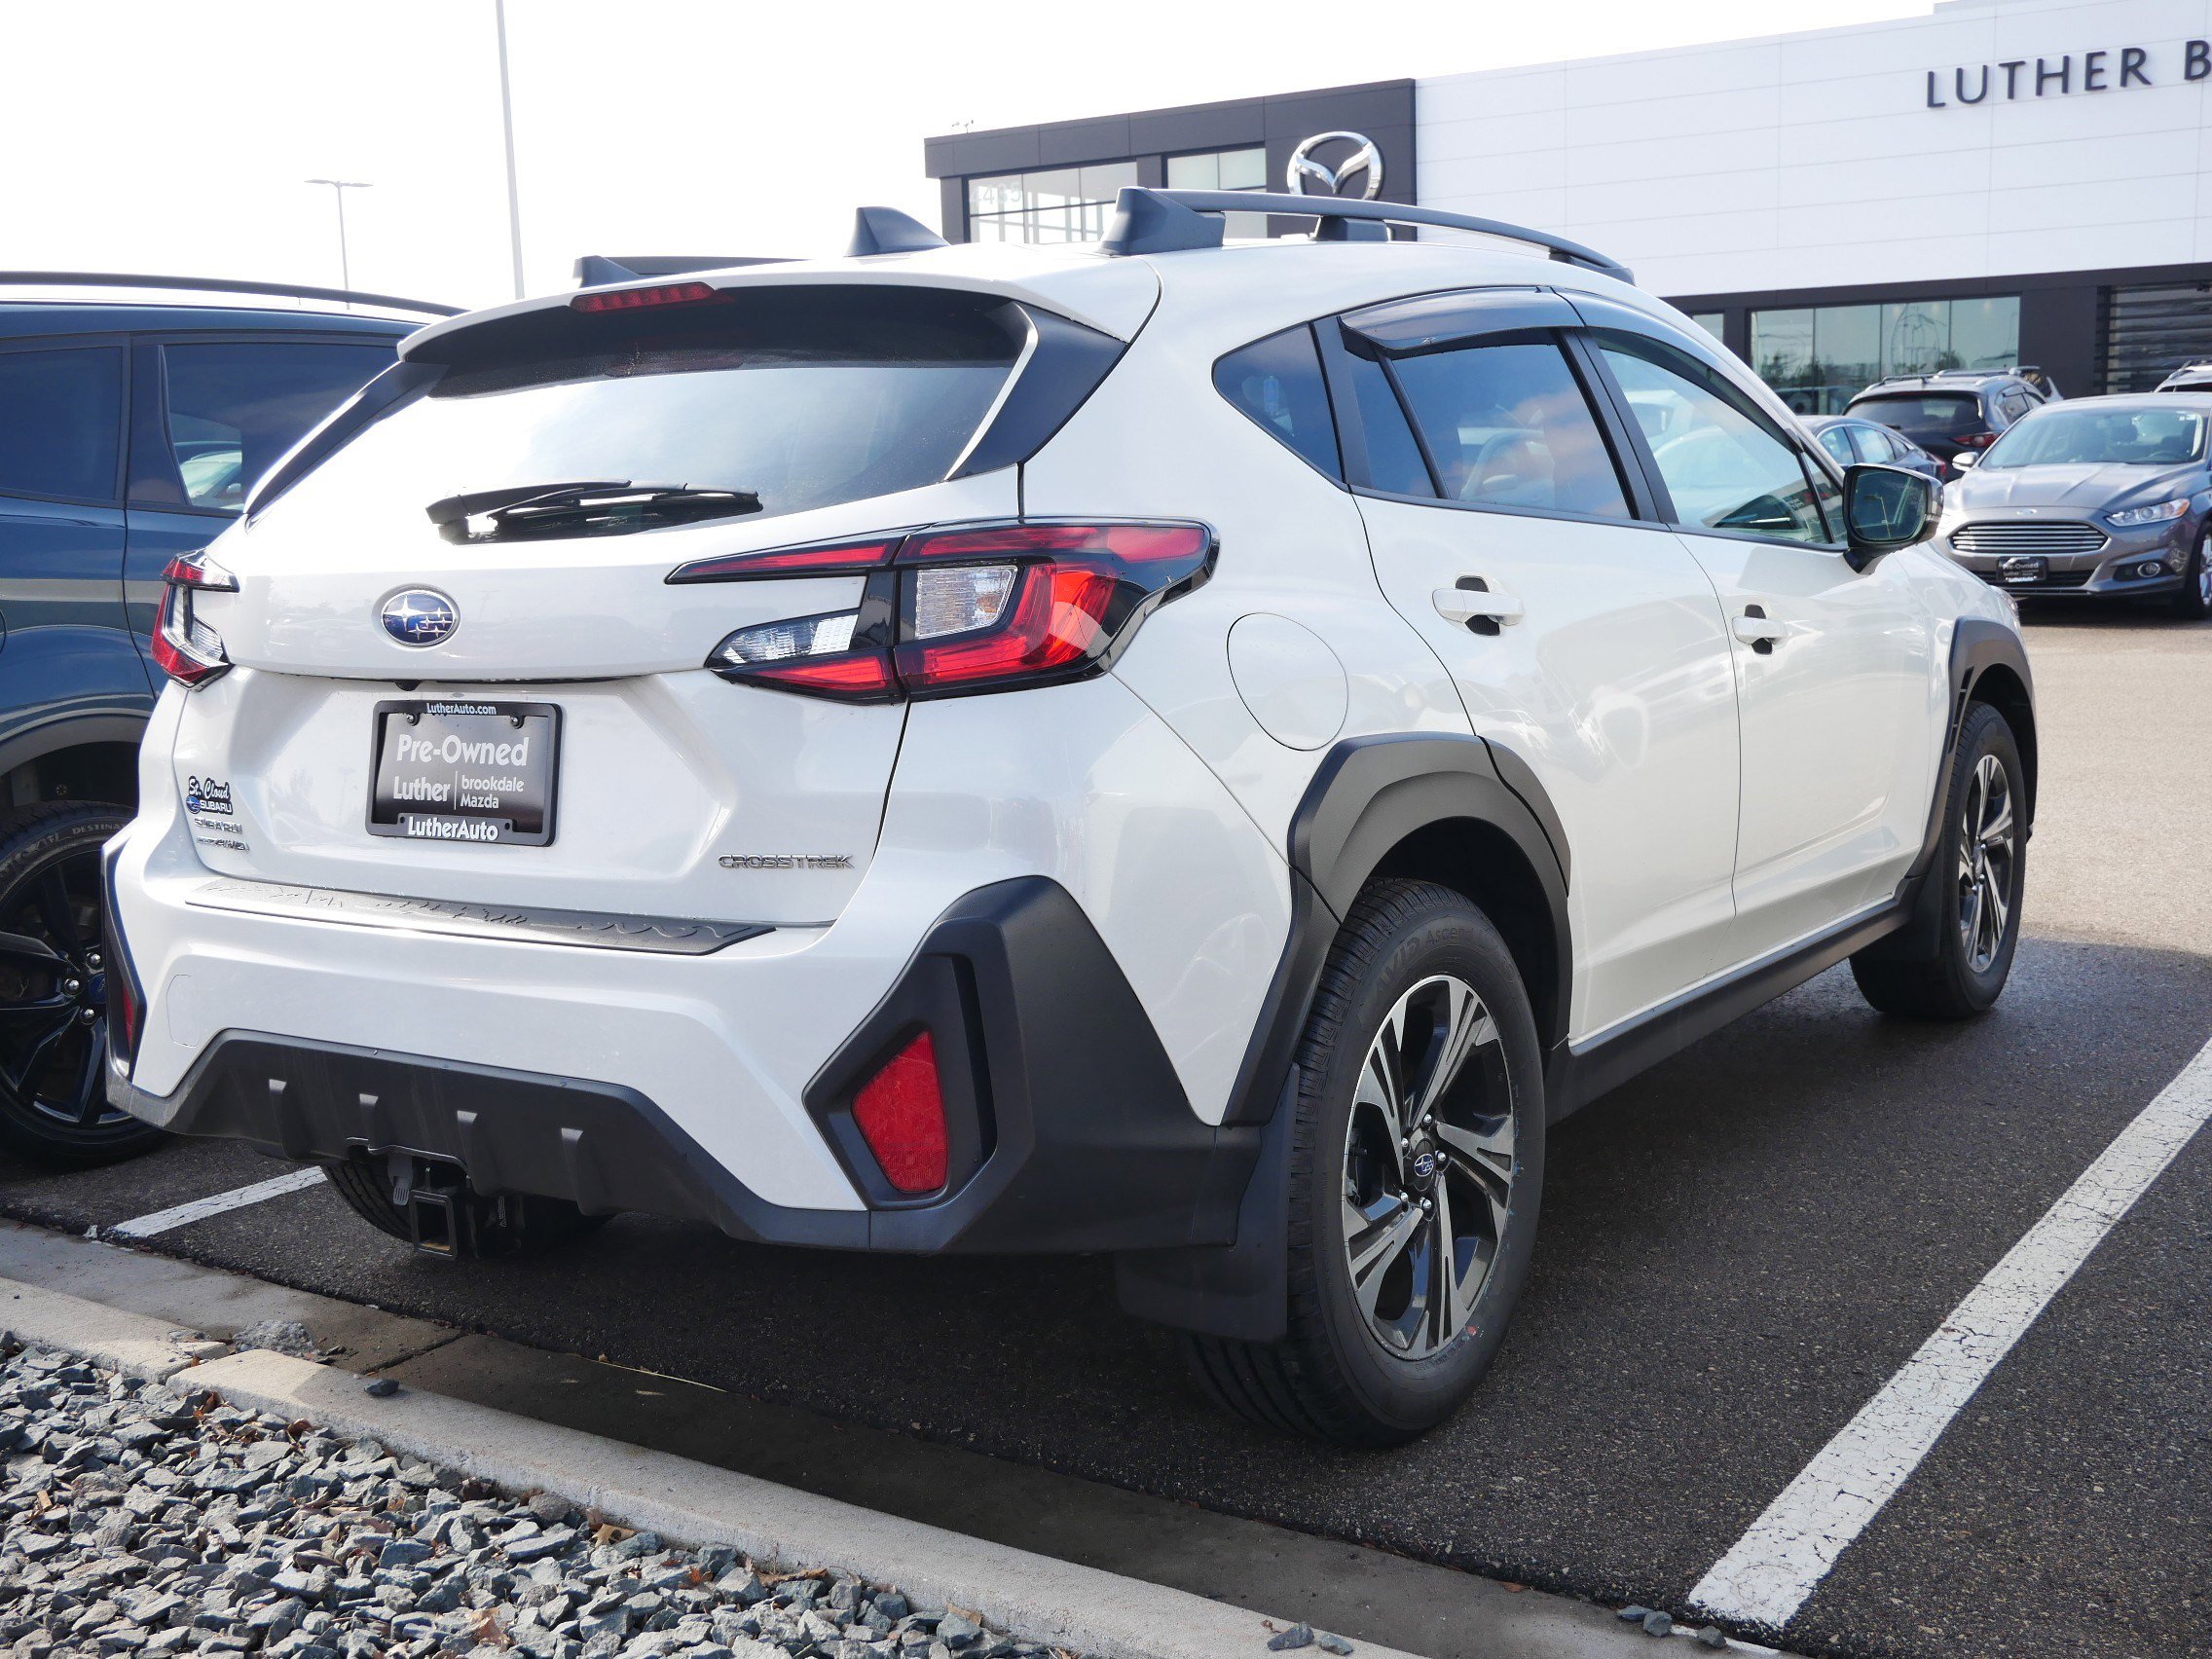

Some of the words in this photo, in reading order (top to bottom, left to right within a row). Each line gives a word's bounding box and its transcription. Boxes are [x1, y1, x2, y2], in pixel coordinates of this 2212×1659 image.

[1927, 47, 2153, 108] LUTHER
[426, 702, 497, 716] LutherAuto.com
[396, 733, 530, 766] Pre-Owned
[189, 777, 202, 795] St.
[204, 780, 230, 799] Cloud
[393, 776, 451, 802] Luther
[461, 775, 525, 793] brookdale
[200, 799, 233, 813] SUBARU
[461, 793, 499, 809] Mazda
[195, 817, 242, 834] SUBARU
[408, 816, 498, 841] LutherAuto
[719, 854, 855, 869] CROSSTREK
